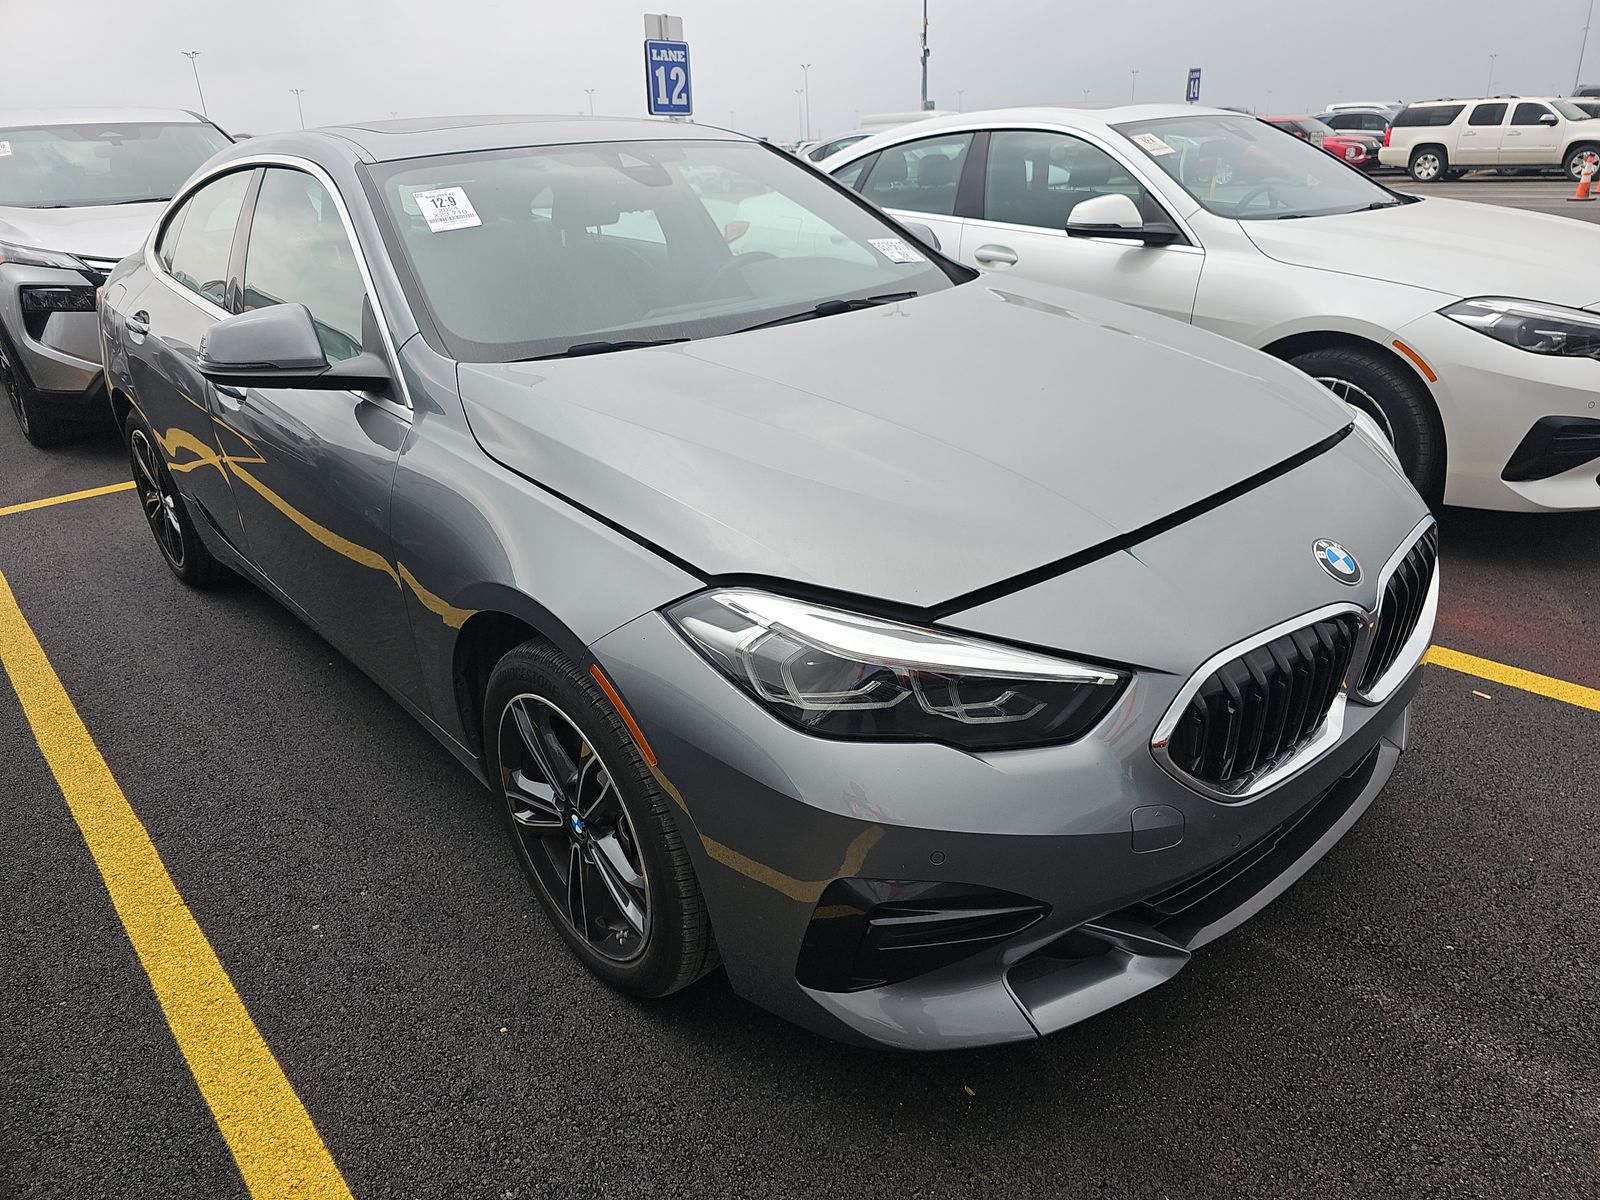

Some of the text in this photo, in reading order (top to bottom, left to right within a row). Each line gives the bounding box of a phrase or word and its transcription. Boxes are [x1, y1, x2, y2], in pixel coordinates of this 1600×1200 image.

[651, 49, 686, 63] LANE
[655, 66, 688, 105] 12
[1189, 79, 1199, 98] 14
[430, 196, 457, 209] 12:9
